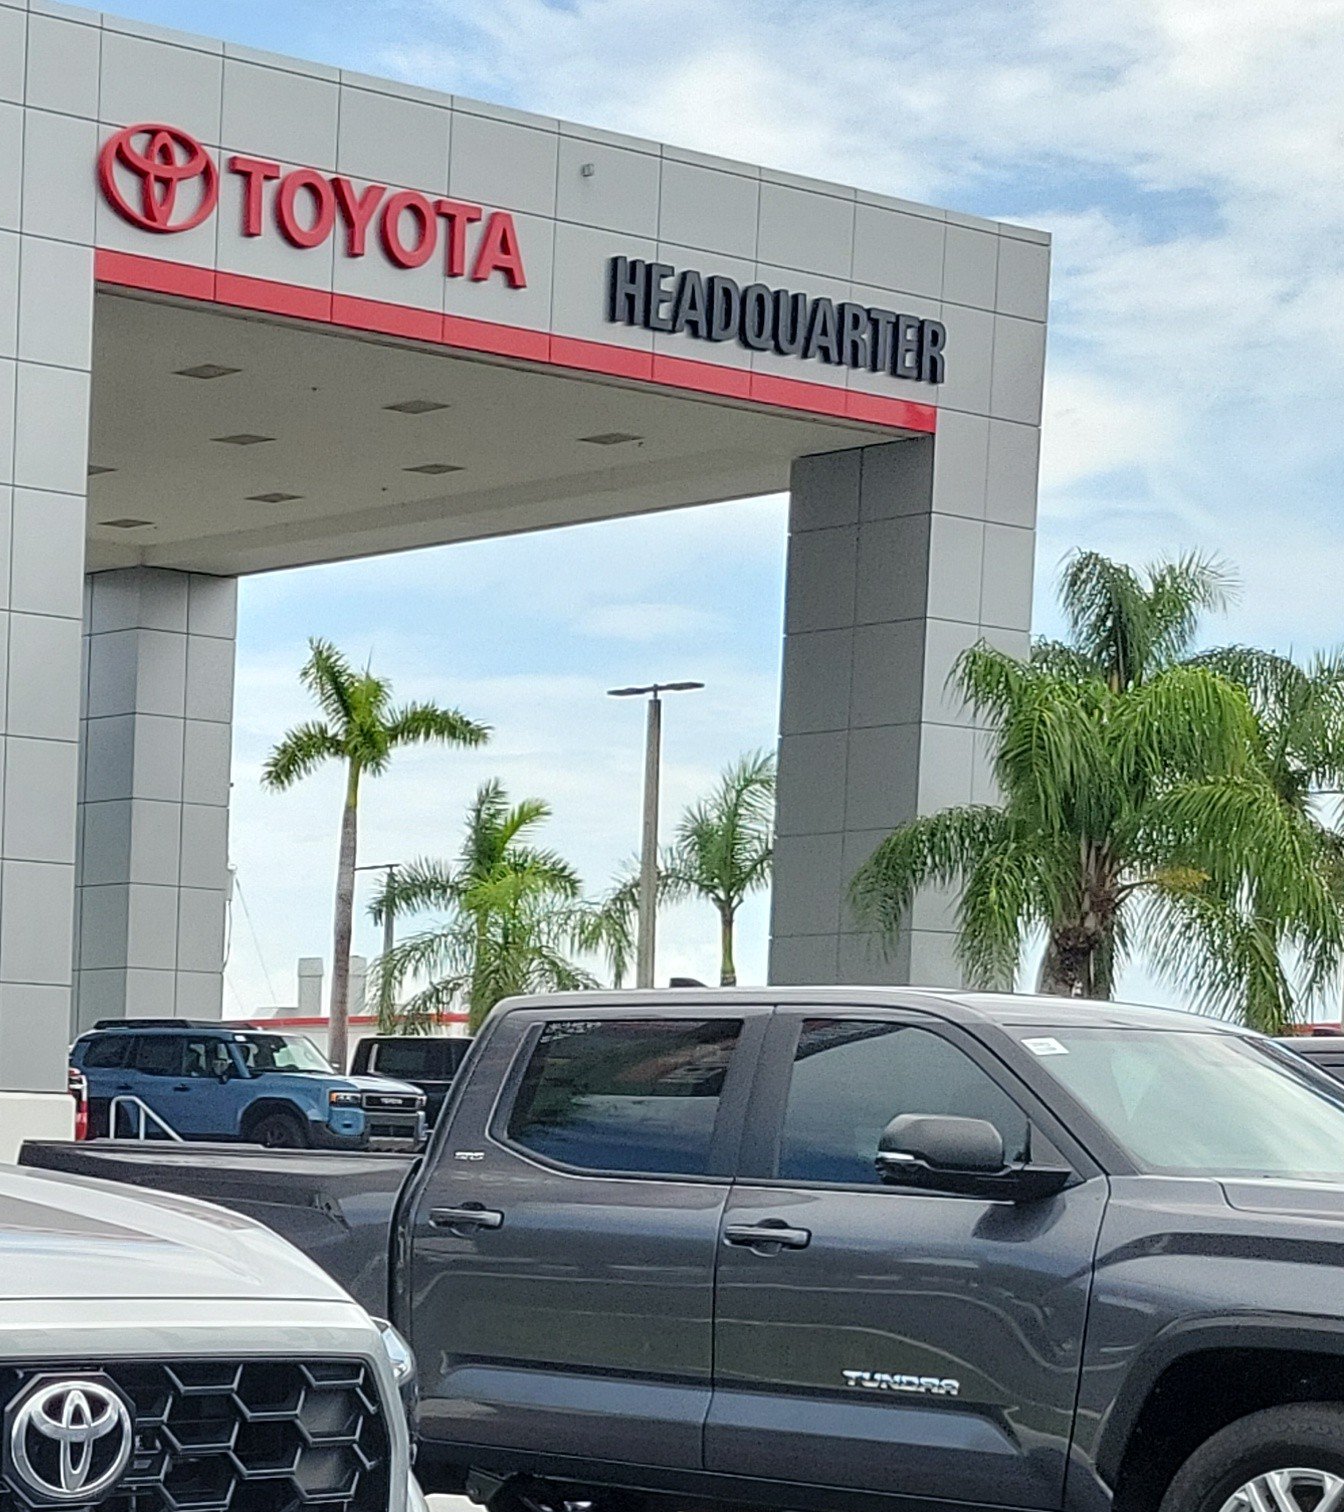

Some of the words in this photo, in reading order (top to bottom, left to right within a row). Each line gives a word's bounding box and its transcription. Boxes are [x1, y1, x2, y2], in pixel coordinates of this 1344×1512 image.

[228, 155, 527, 289] TOYOTA
[605, 255, 948, 385] HEADQUARTER
[842, 1369, 960, 1397] TUNDRA
